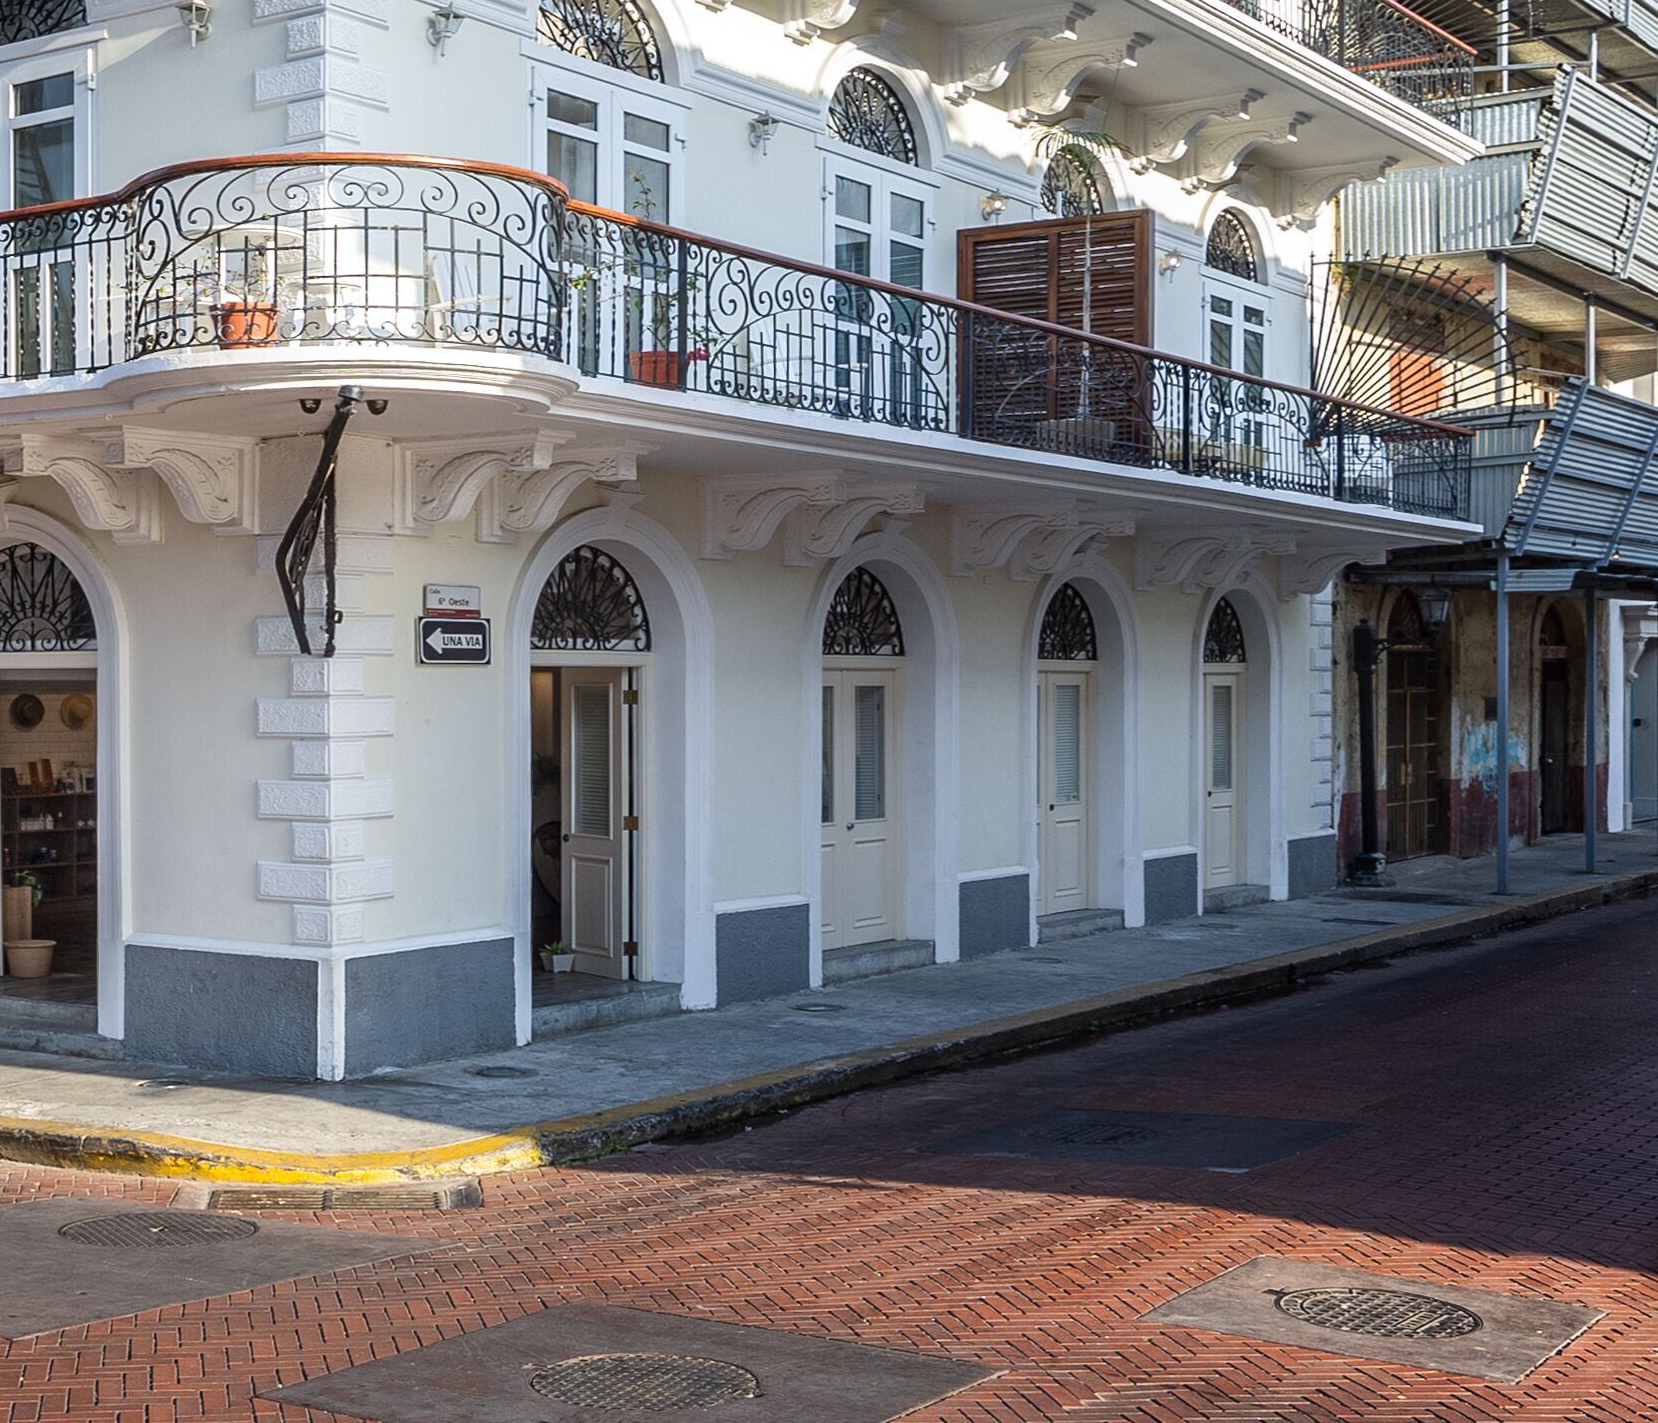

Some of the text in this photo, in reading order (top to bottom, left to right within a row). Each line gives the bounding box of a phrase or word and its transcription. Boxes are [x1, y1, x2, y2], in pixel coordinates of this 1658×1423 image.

[448, 597, 470, 607] Oeste
[442, 635, 481, 647] UNA VIA
